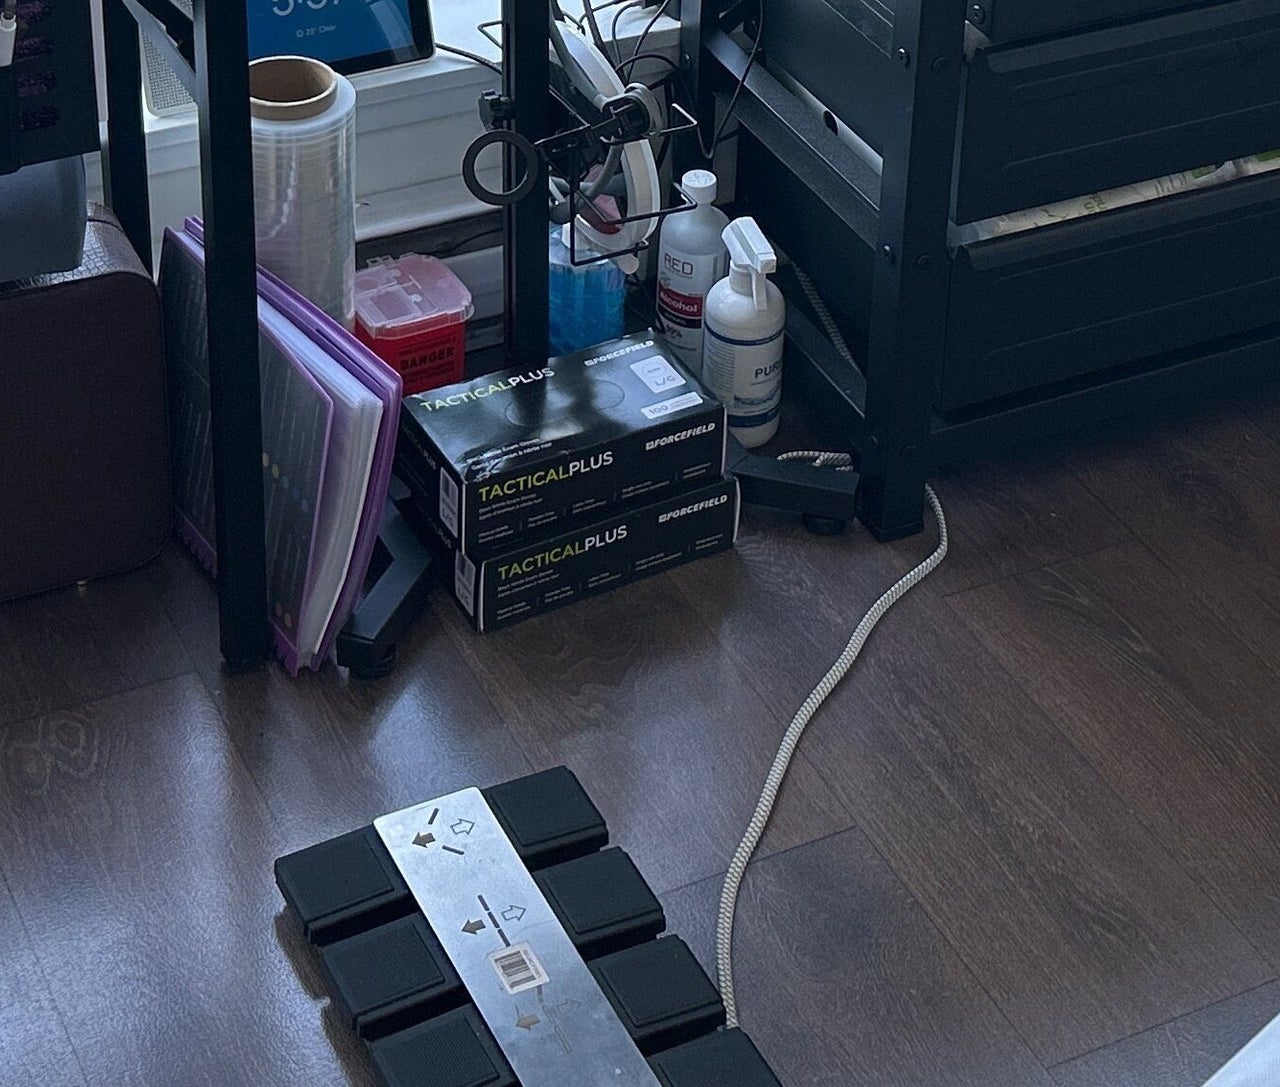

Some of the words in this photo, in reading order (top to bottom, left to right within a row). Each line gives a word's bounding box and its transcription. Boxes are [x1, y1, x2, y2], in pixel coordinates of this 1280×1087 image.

[664, 253, 693, 275] RED
[401, 346, 455, 371] DANGER
[593, 340, 655, 363] FORCEFIELD
[420, 367, 555, 412] TACTICALPLUS
[649, 404, 669, 415] 100
[653, 423, 716, 450] FORCEFIELD
[478, 451, 613, 502] TACTICALPLUS
[666, 495, 728, 521] FORCEFIELD
[497, 524, 628, 580] TACTICALPLUS
